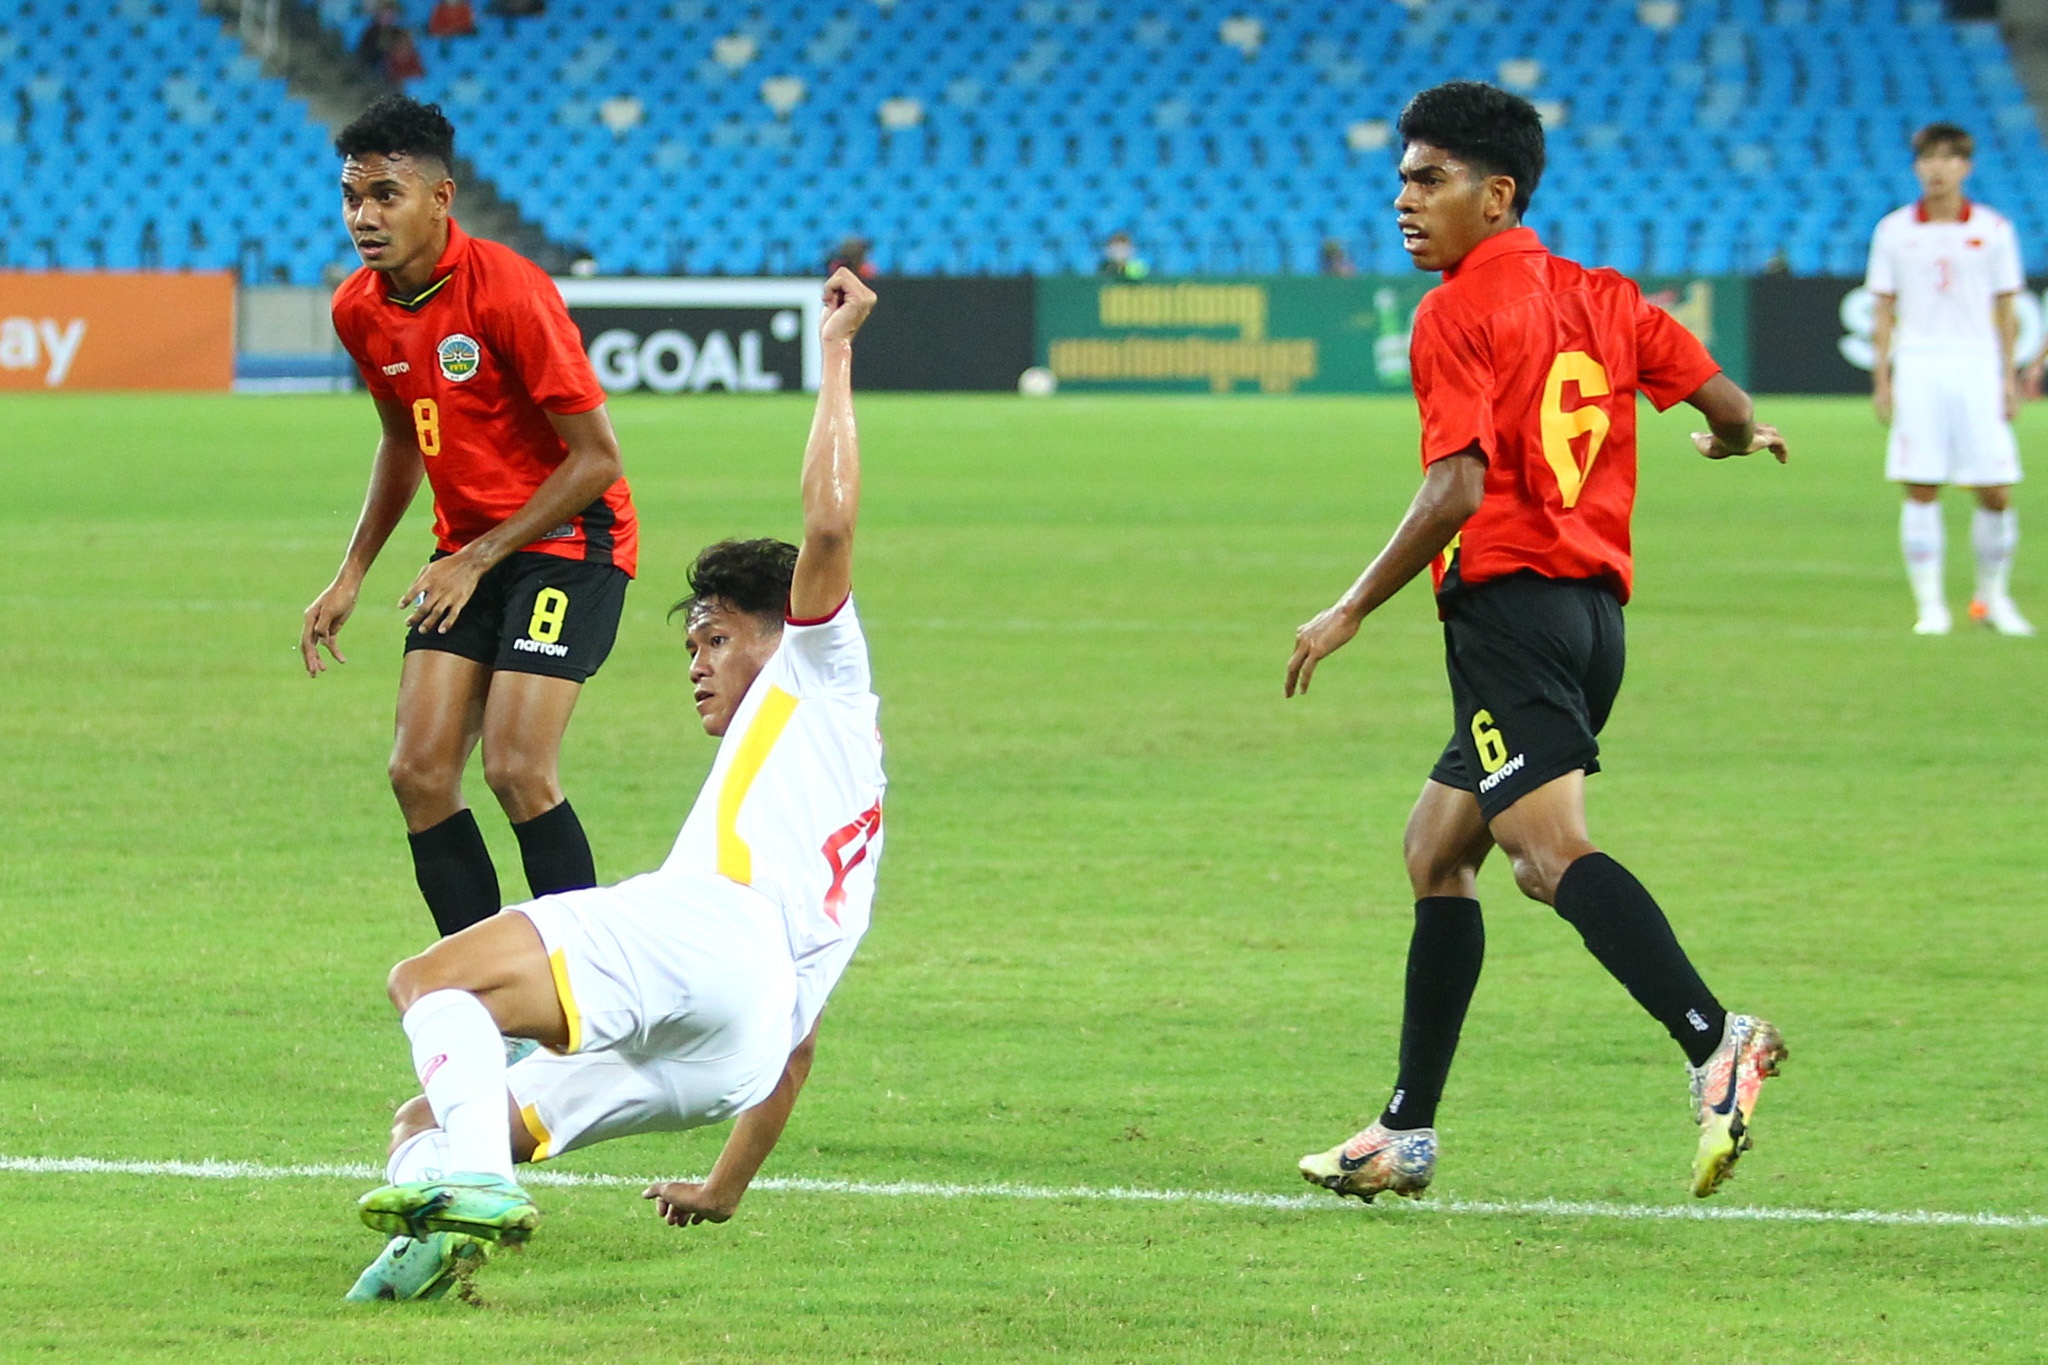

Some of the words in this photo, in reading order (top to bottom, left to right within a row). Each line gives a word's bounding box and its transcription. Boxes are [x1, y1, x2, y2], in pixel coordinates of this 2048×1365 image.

[587, 328, 782, 394] GOAL
[412, 398, 440, 457] 8
[1540, 351, 1610, 509] 6
[527, 587, 569, 644] 8
[513, 638, 569, 657] narrow
[1471, 708, 1508, 774] 6
[1479, 753, 1525, 794] narrow
